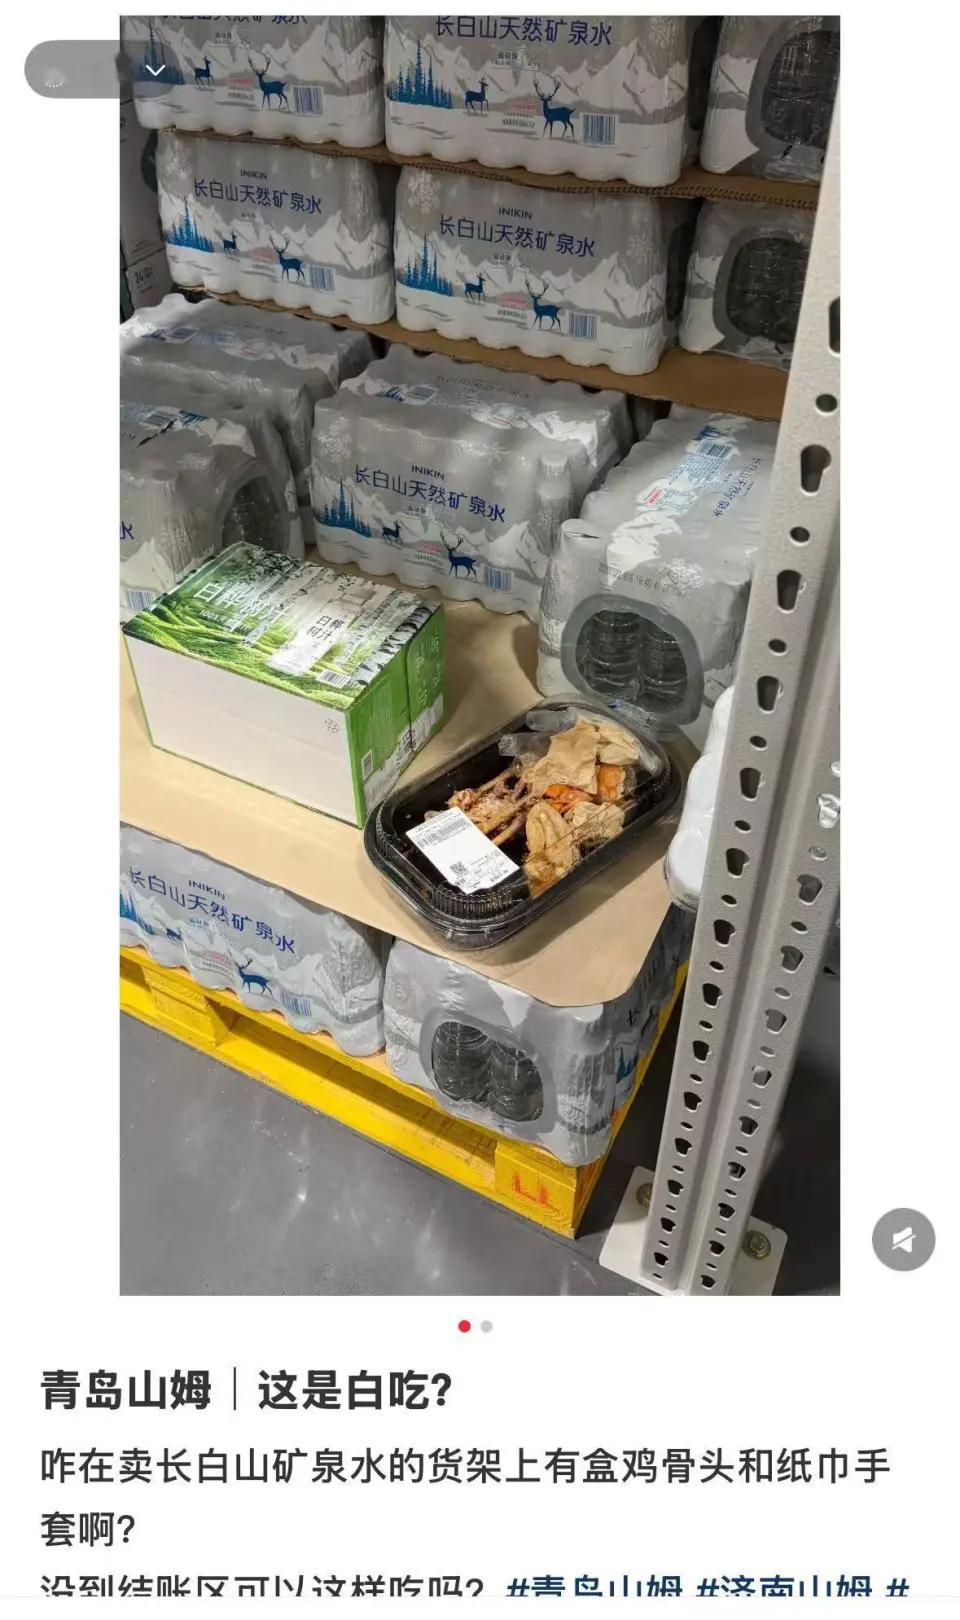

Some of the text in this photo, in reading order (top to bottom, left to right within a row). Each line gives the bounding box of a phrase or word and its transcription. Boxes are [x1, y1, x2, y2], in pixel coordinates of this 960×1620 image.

[435, 16, 613, 47] 长白山天然矿泉水
[194, 178, 322, 215] 长白山天然矿泉水
[498, 206, 533, 220] INIKIN
[439, 214, 596, 258] 长白山天然矿泉水
[411, 464, 445, 481] INIKIN
[355, 463, 506, 523] 长白山天然矿泉水
[188, 878, 226, 901] INIKIN
[129, 866, 296, 954] 长白山天然矿泉水
